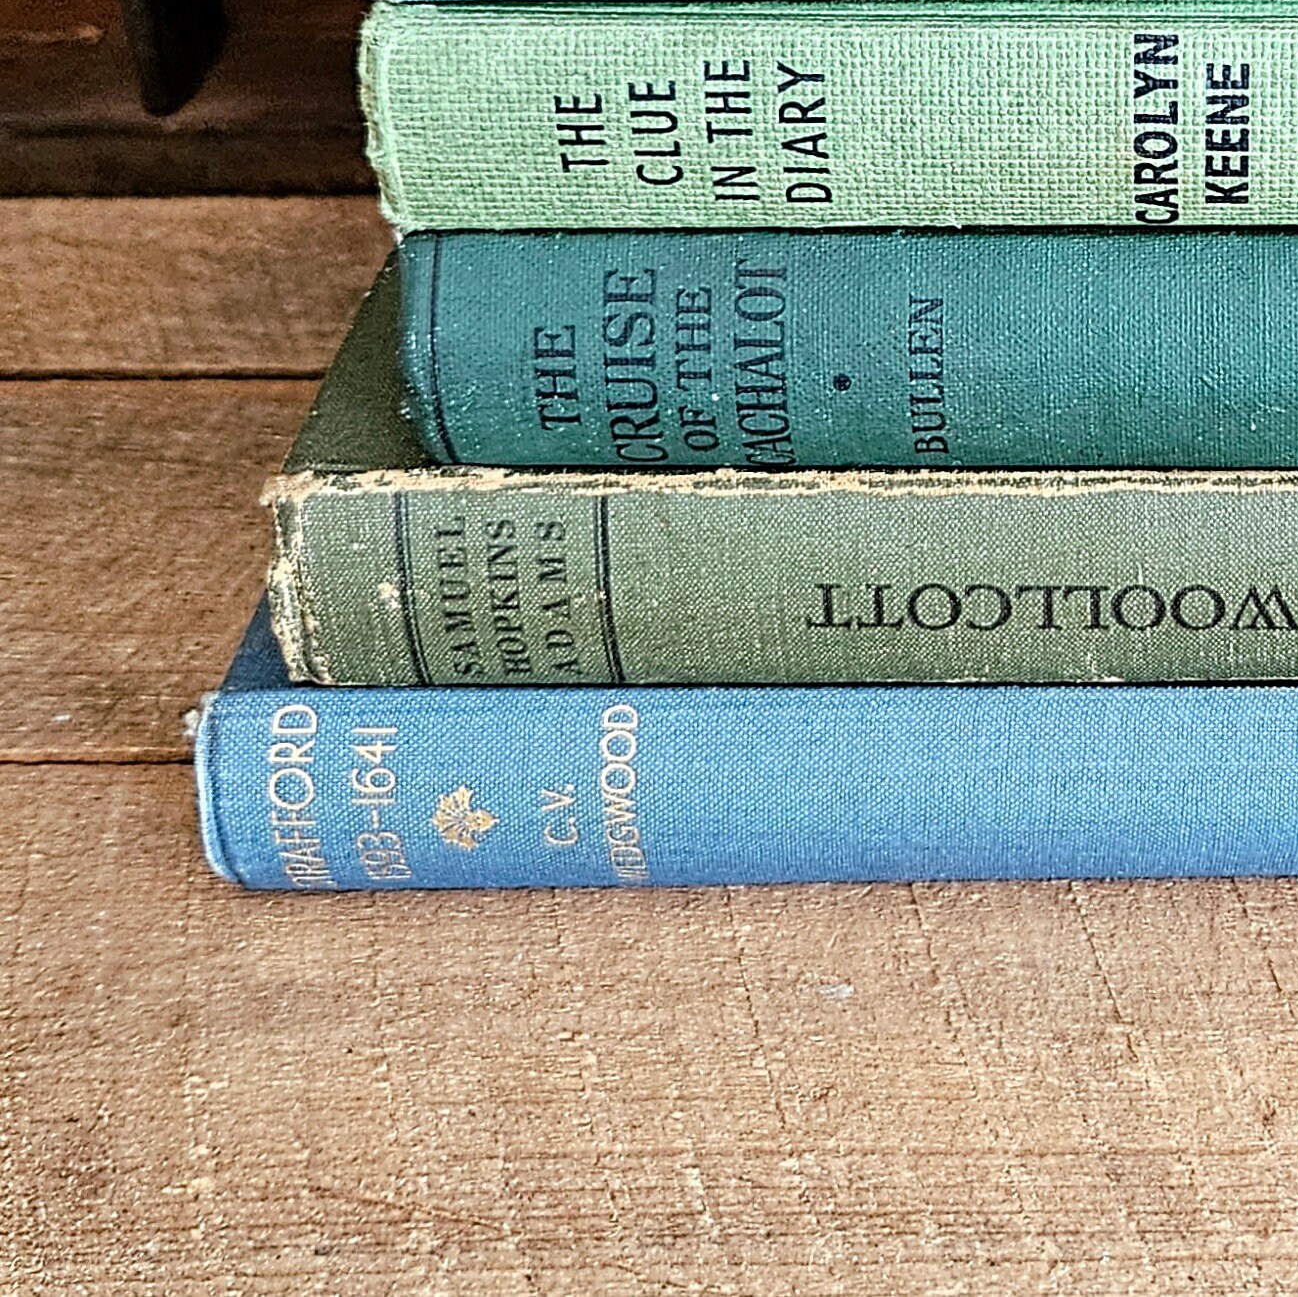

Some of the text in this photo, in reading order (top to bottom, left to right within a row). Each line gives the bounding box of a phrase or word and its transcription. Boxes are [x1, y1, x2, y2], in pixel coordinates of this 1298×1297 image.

[554, 93, 610, 172] THE
[628, 80, 684, 185] CLUE
[704, 60, 760, 201] IN THE
[776, 61, 833, 202] DIARY
[1133, 34, 1179, 224] CAROLYN
[1205, 63, 1250, 204] KEENE
[534, 324, 581, 431] THE
[602, 268, 669, 463] CRUISE
[675, 287, 719, 452] OF THE
[734, 258, 797, 466] CACHALOT
[908, 295, 949, 454] BULLEN
[435, 517, 484, 675] SAMUEL
[485, 519, 531, 673] HOPKINS
[535, 521, 582, 674] ADAMS
[268, 703, 337, 887] TRAFFORD
